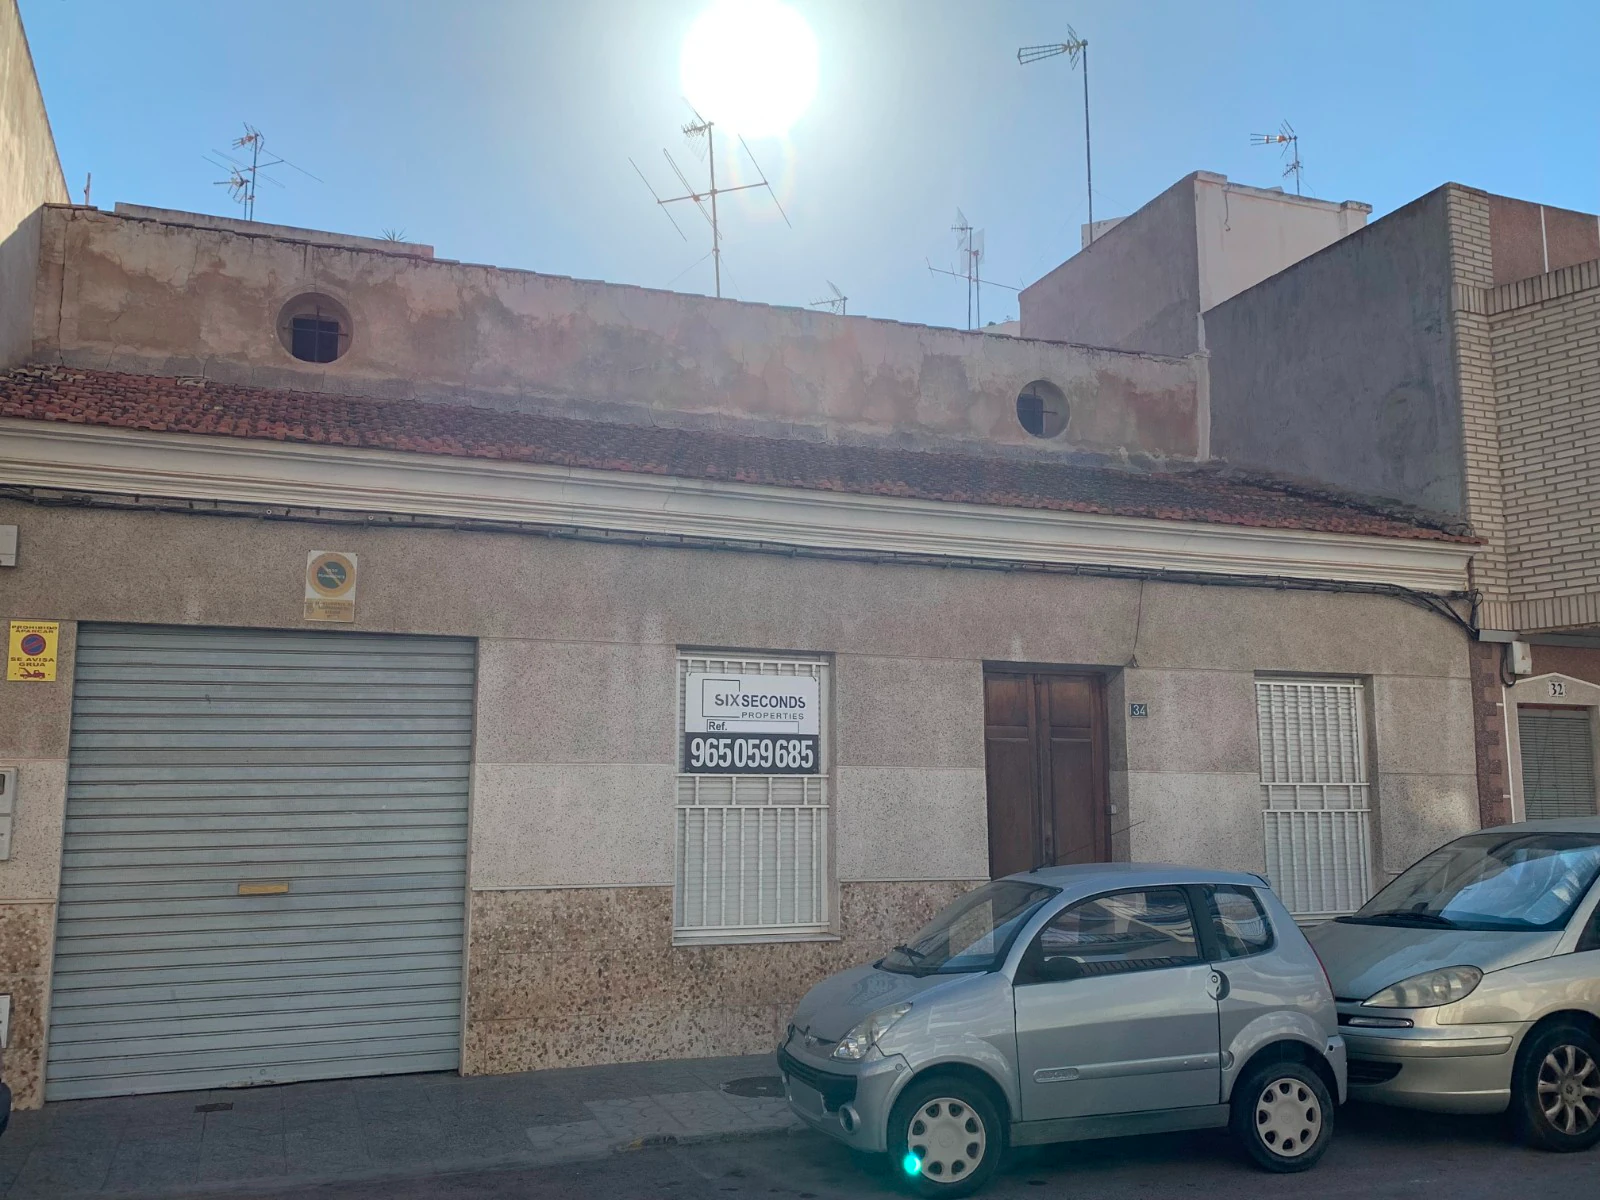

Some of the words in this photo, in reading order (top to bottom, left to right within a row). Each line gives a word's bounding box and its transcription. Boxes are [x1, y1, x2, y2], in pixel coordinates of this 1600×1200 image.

[1551, 683, 1563, 695] 32
[741, 711, 805, 720] PROPERTIES
[1133, 704, 1146, 716] 34
[708, 721, 728, 731] Ref.
